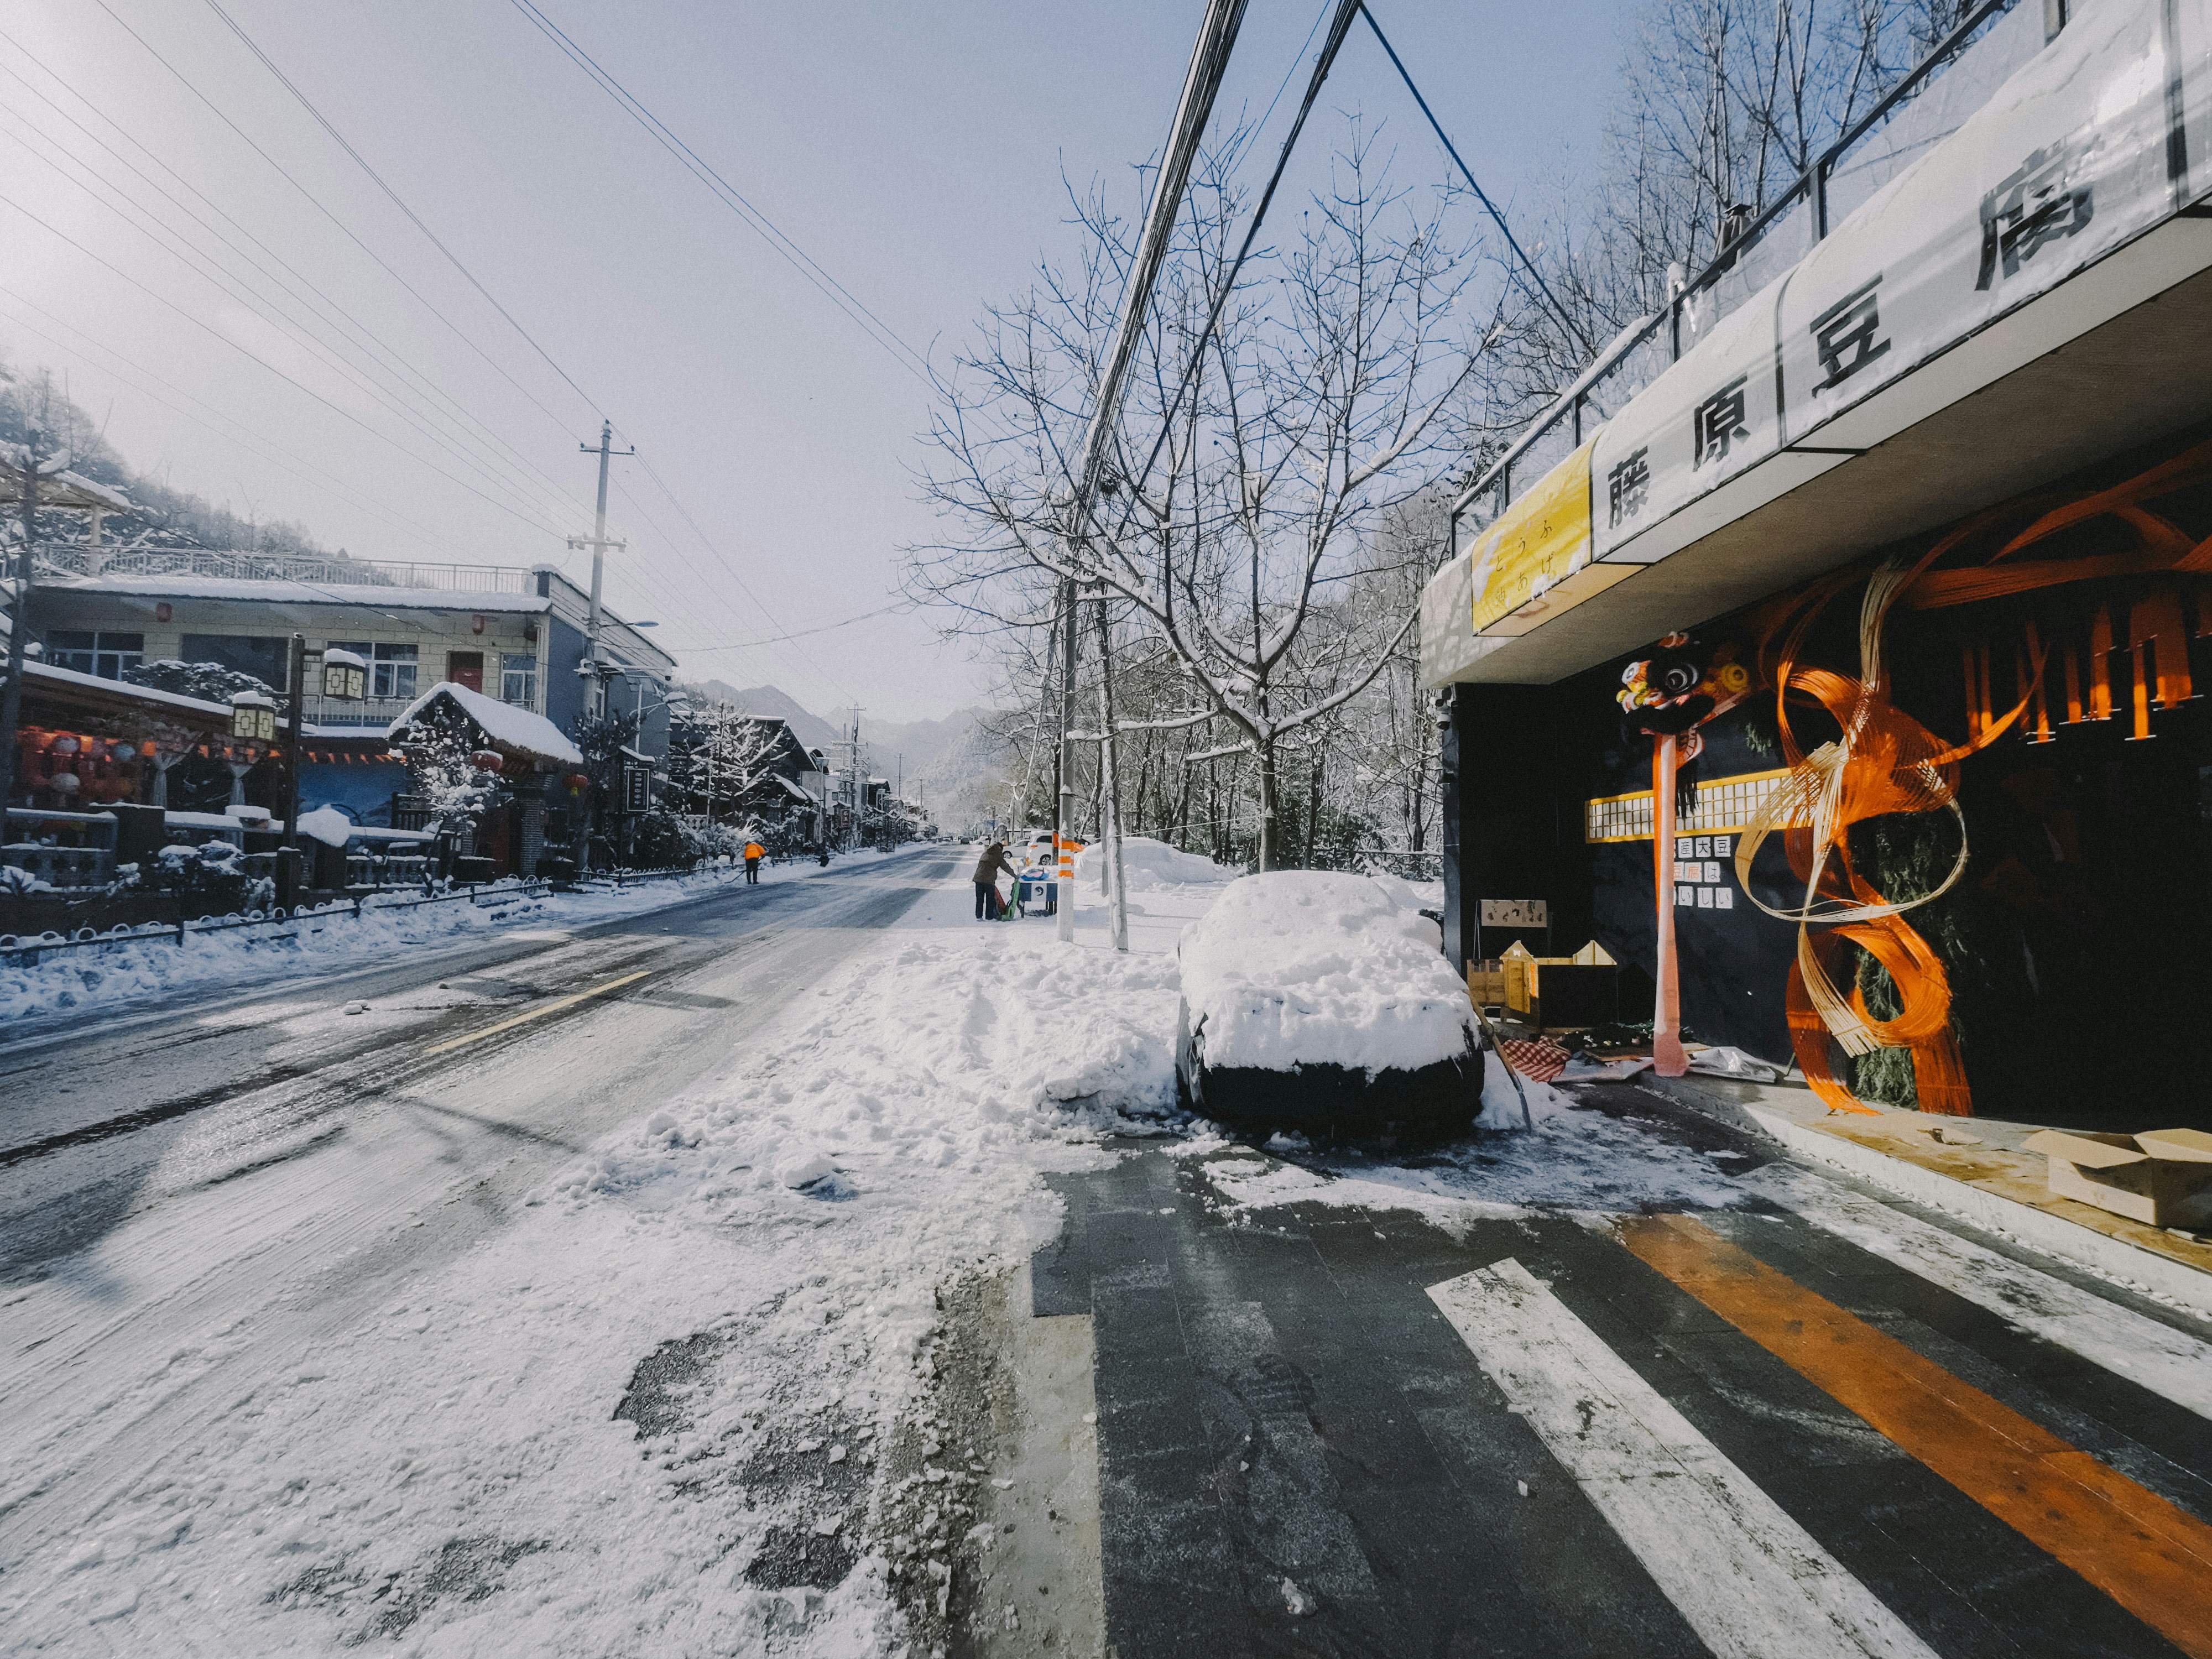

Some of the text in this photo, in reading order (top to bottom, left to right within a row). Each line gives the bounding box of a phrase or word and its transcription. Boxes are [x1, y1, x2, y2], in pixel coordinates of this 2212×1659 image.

[1496, 520, 1552, 572] とうふ
[1681, 839, 1728, 854] 産大豆
[1681, 890, 1729, 905] いしい
